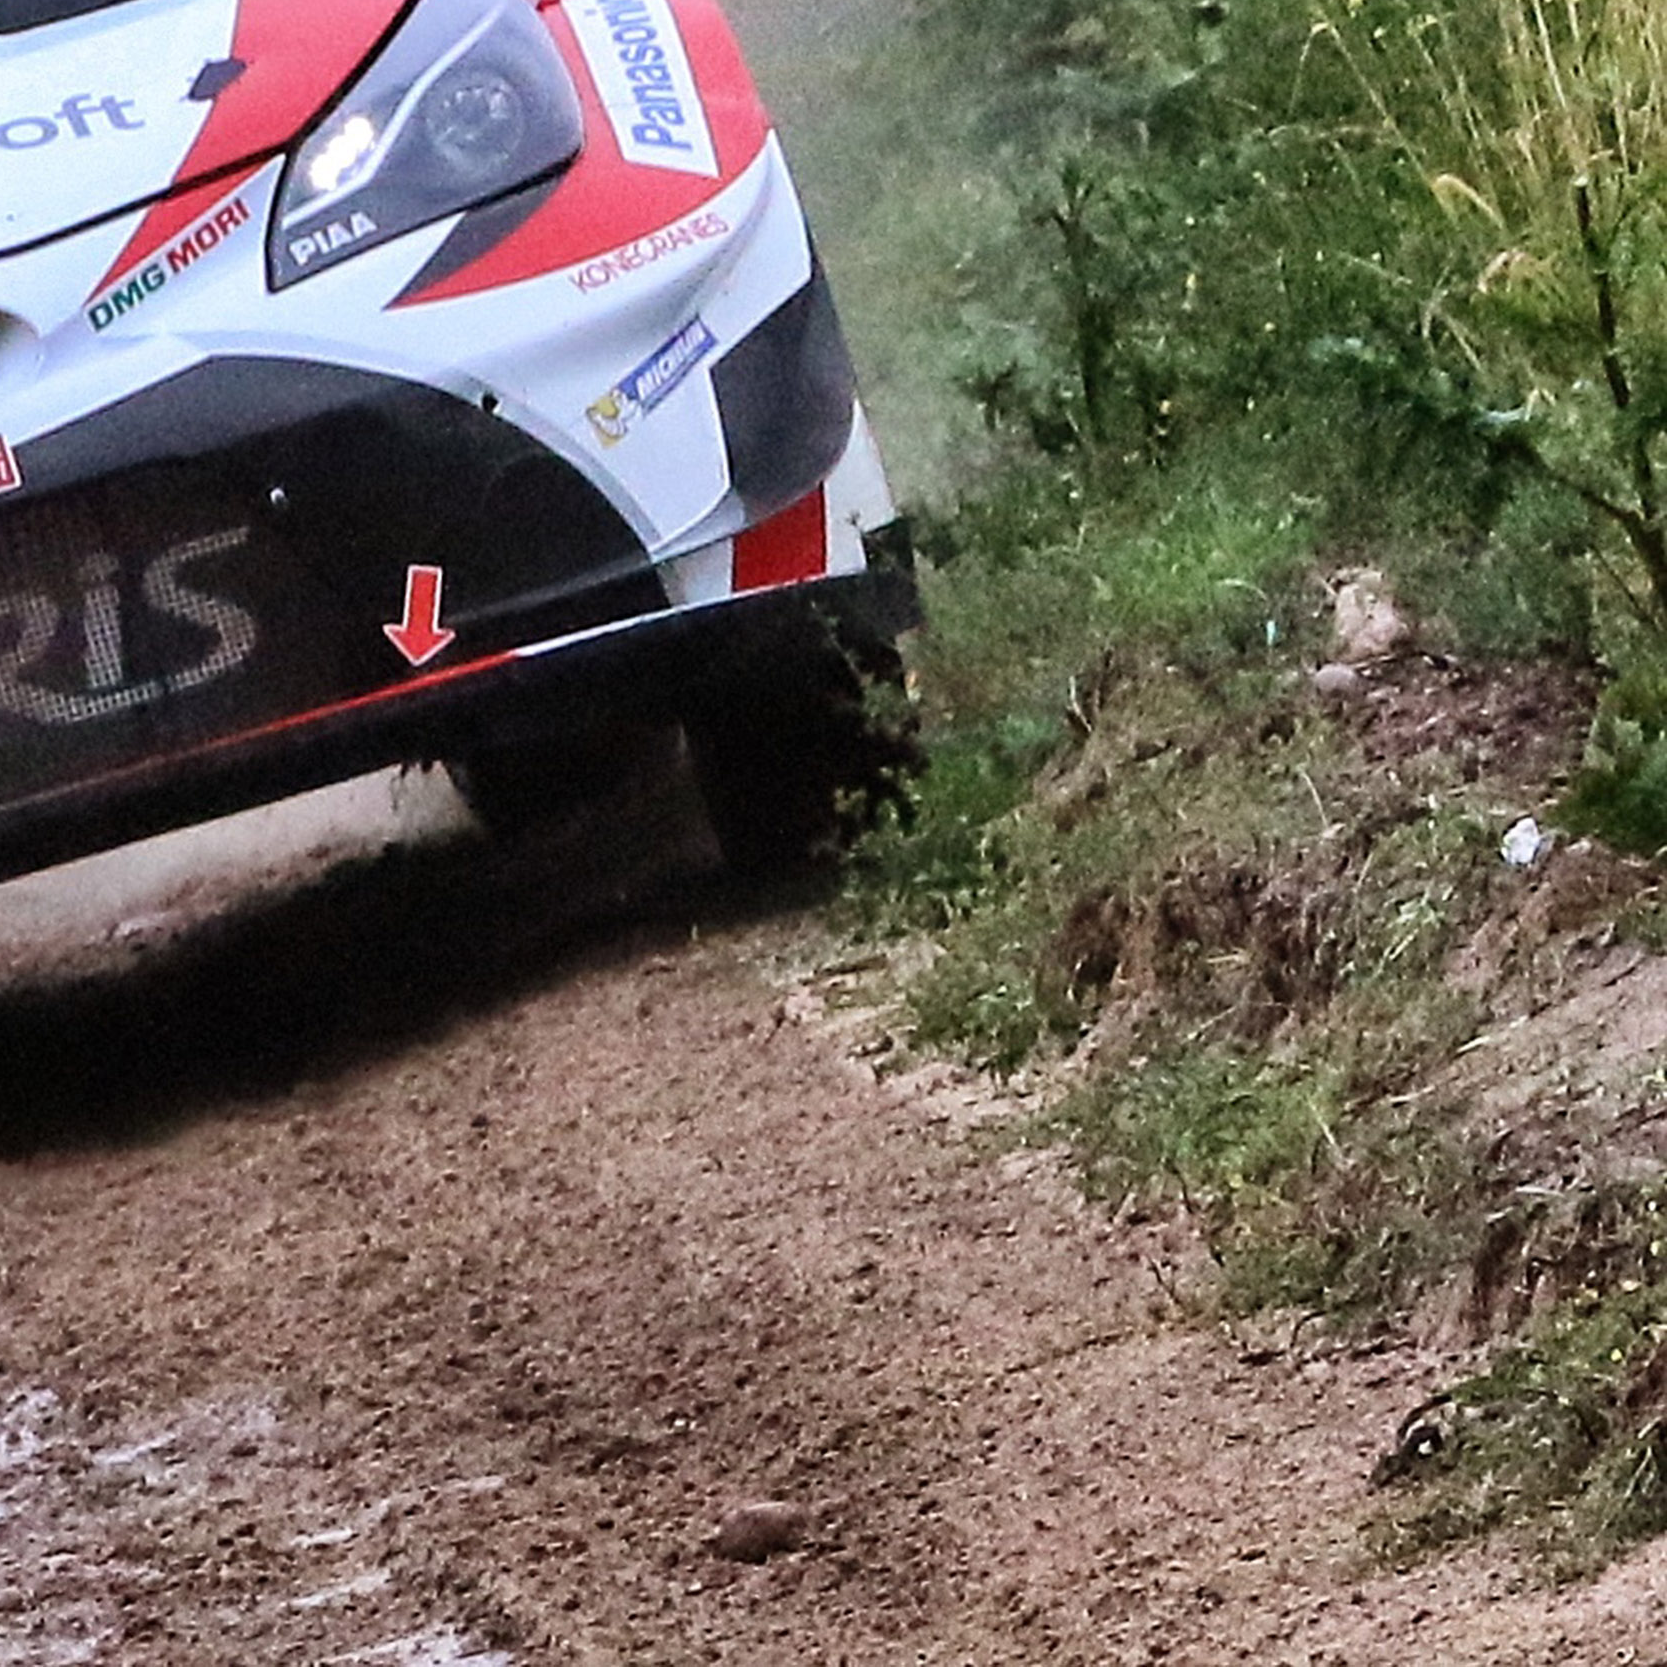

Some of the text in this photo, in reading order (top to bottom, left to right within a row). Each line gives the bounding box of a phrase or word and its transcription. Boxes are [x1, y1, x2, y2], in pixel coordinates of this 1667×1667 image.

[87, 197, 251, 332] DMG MORI
[288, 211, 378, 266] PIAA
[569, 212, 731, 294] KONECRANES
